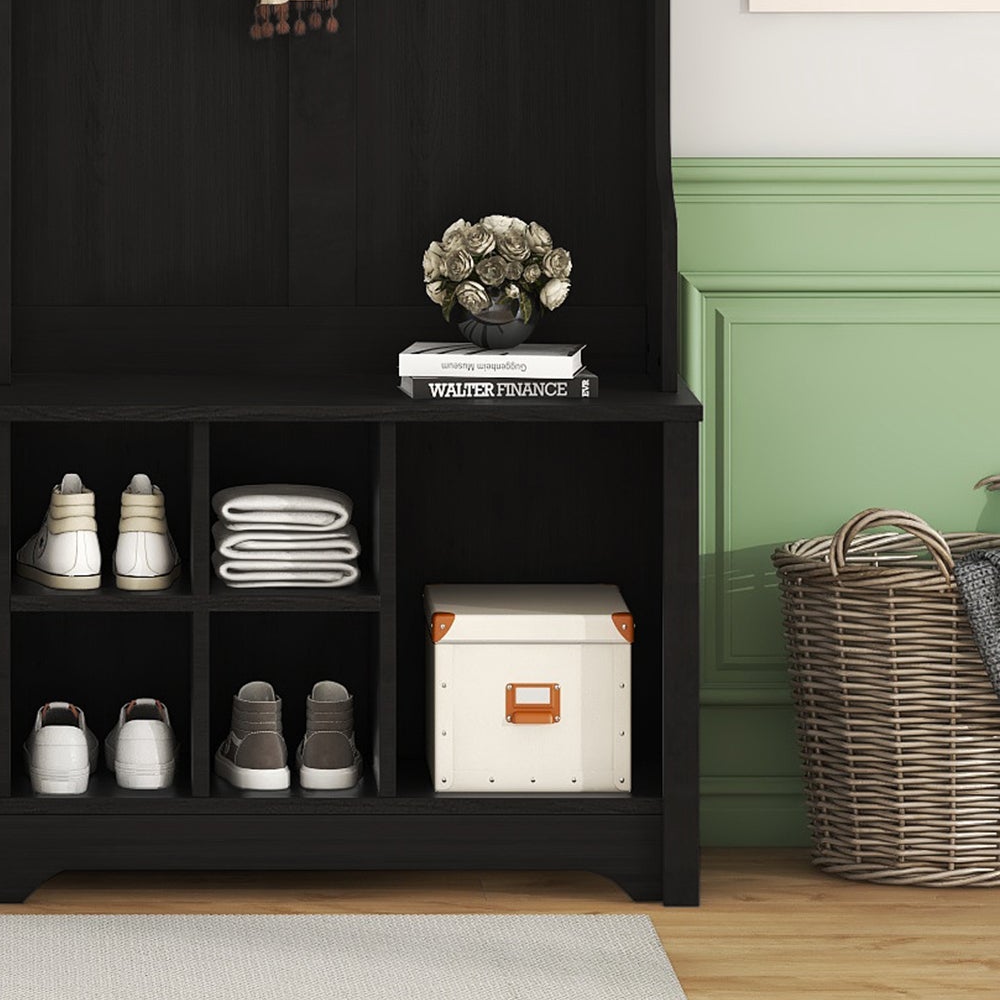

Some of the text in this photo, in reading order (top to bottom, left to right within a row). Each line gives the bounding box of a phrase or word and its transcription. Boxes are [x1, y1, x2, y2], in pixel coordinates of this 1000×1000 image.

[441, 361, 528, 372] Guggenheim Museum
[428, 382, 568, 398] WALTER FINANCE
